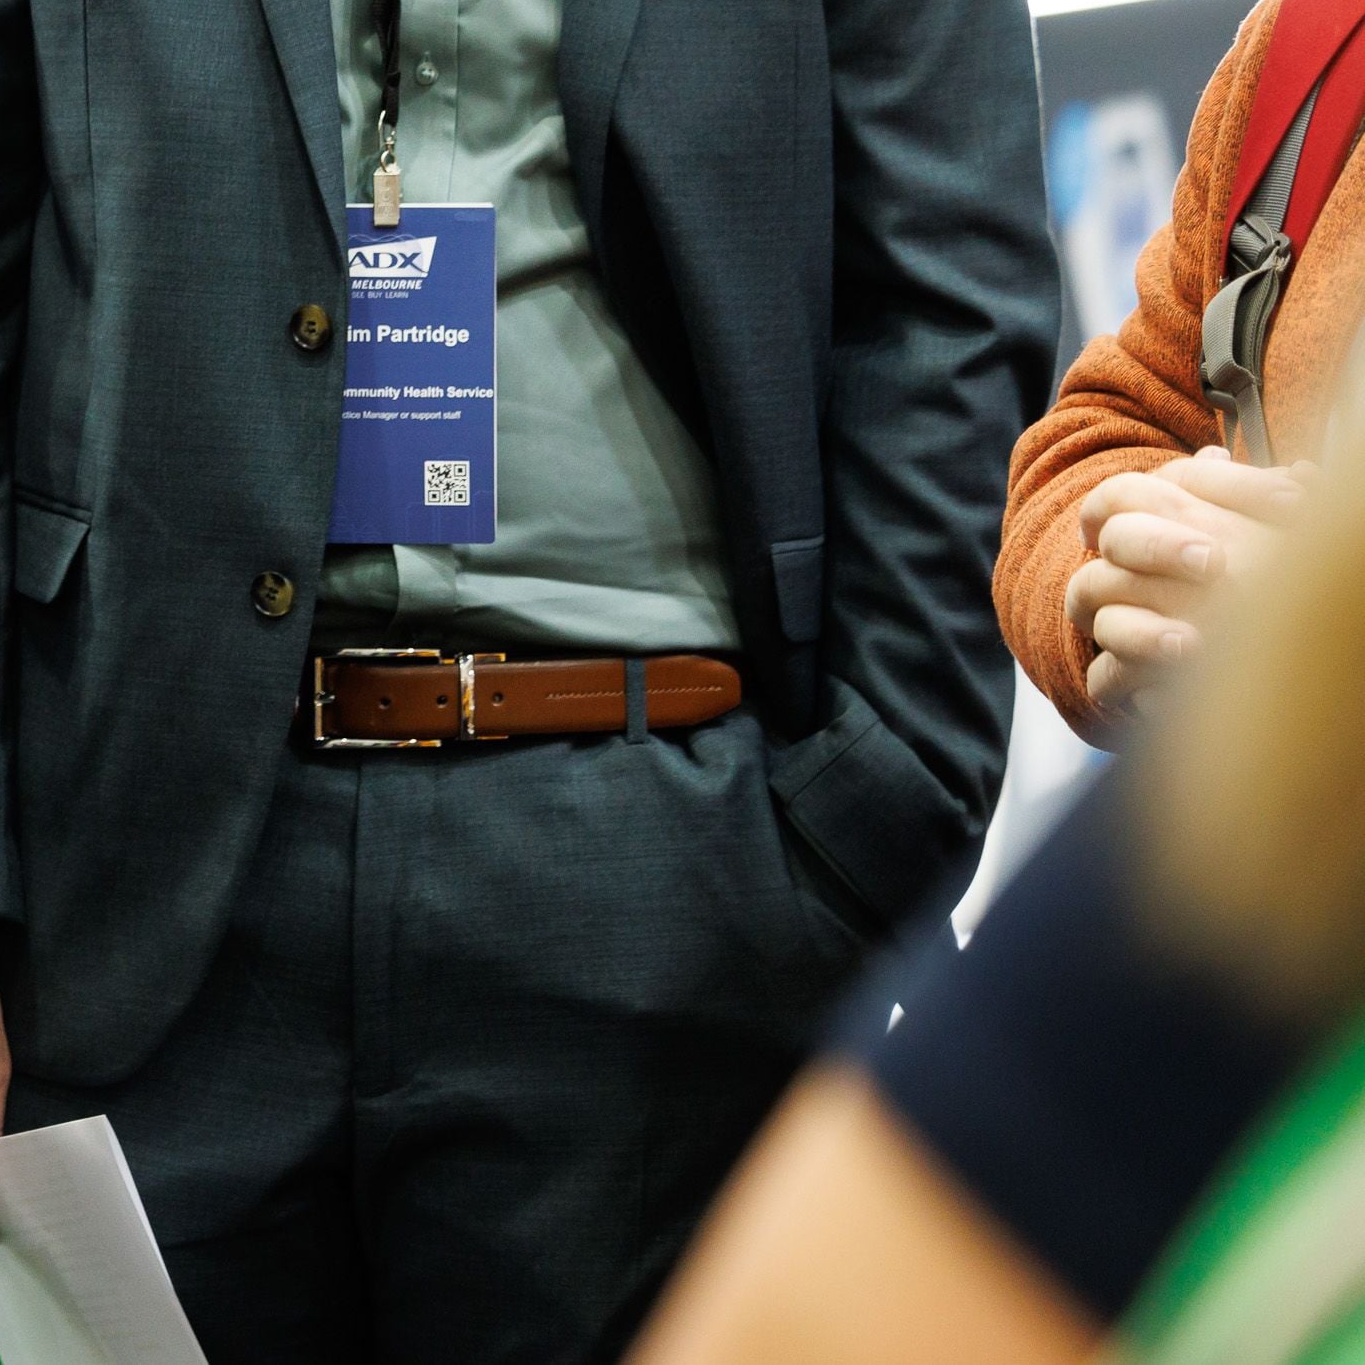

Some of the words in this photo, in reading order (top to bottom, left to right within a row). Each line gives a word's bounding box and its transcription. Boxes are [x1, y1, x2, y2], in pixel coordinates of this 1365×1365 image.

[349, 251, 428, 273] ADX
[351, 279, 423, 290] MELBOURNE
[347, 325, 371, 342] im
[377, 325, 469, 347] Partridge
[403, 386, 444, 398] Health
[447, 386, 493, 398] Service
[342, 410, 361, 419] ctice
[363, 411, 398, 421] Manager
